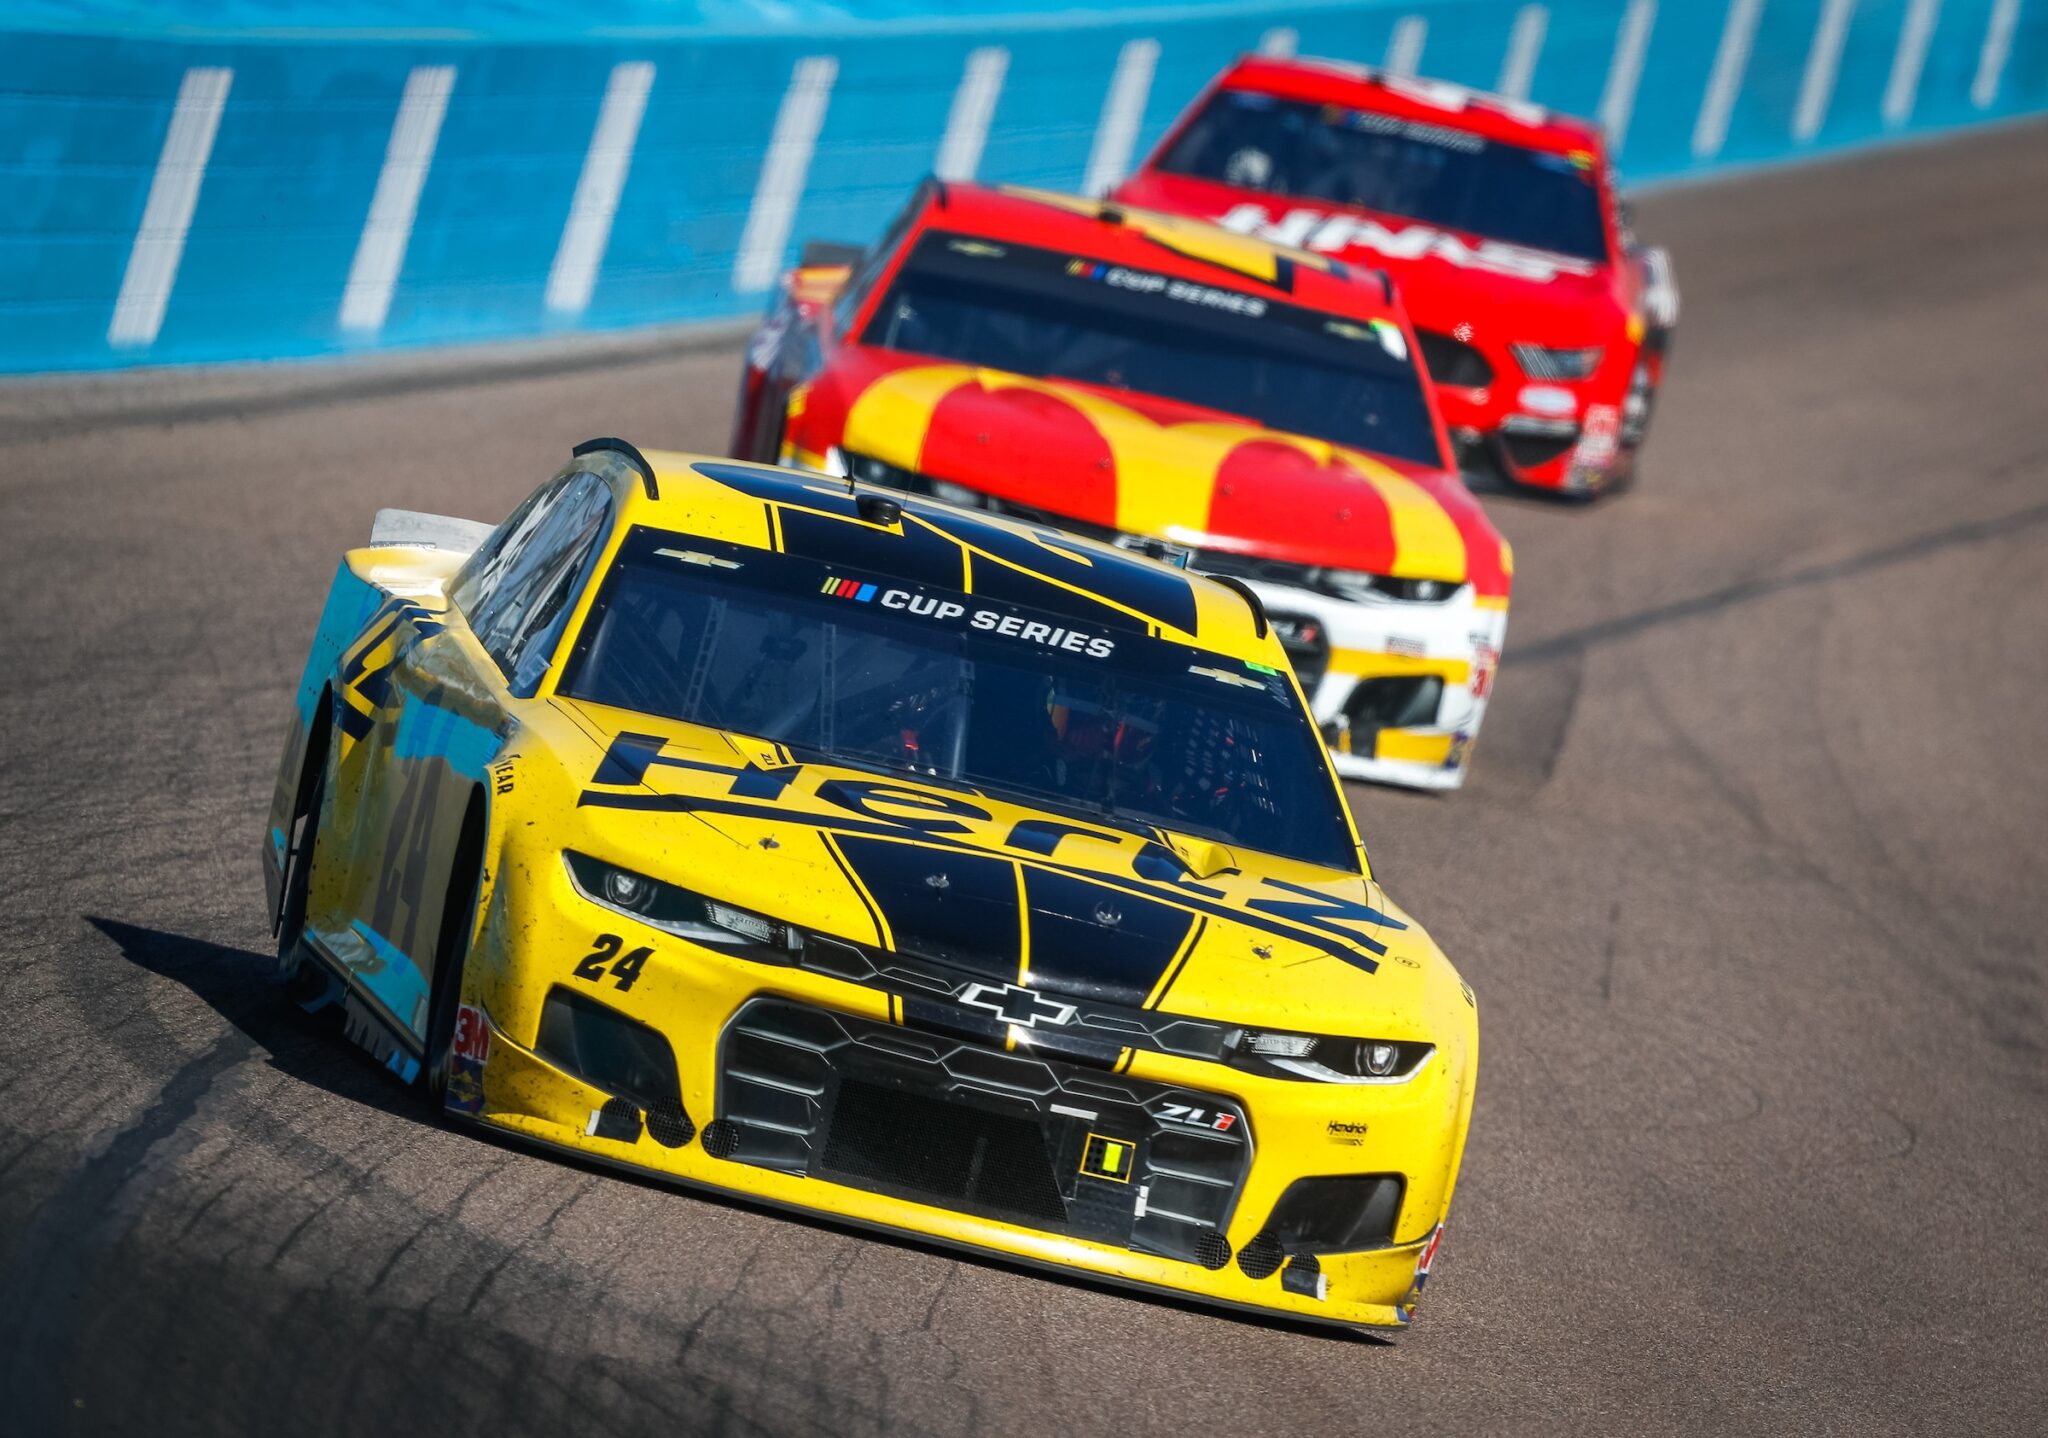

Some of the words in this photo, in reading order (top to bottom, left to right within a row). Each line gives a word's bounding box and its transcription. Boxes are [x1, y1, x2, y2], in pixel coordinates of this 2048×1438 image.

[1105, 267, 1167, 293] CUP
[1167, 279, 1267, 318] SERIES
[880, 589, 965, 619] CUP
[970, 610, 1115, 658] SERIES
[588, 731, 1409, 958] Hertz
[572, 933, 655, 992] 24
[453, 1006, 490, 1065] 3M
[1153, 1102, 1236, 1131] ZL1
